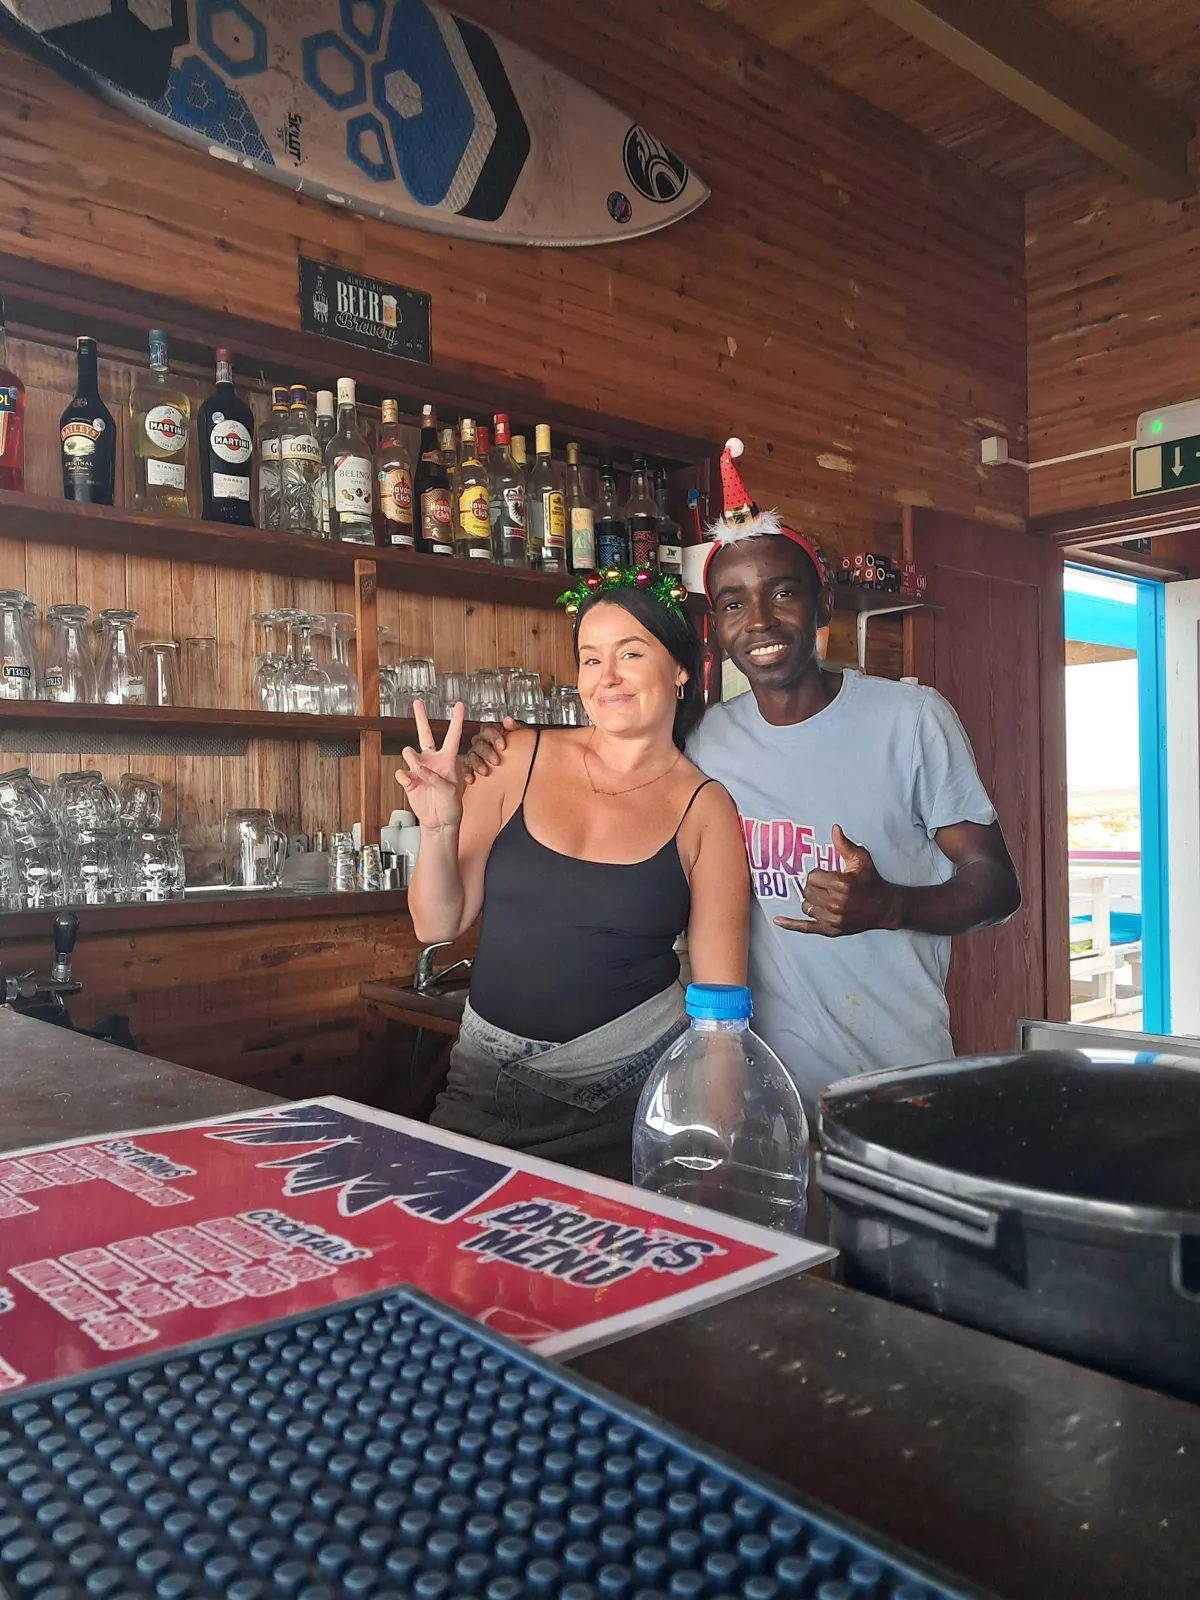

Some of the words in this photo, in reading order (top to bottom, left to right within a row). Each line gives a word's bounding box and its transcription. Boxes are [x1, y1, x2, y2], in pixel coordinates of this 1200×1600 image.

[336, 280, 382, 323] BEER
[335, 310, 399, 349] Brewery
[61, 424, 99, 438] BAILEYS
[150, 421, 186, 436] MARTINI
[215, 435, 249, 449] MARTINI
[157, 464, 180, 472] BIANCO
[395, 494, 411, 504] Club
[738, 814, 814, 876] URF
[246, 1210, 367, 1262] COCKTAILS
[488, 1202, 715, 1270] DRINKS
[464, 1228, 633, 1286] MENU
